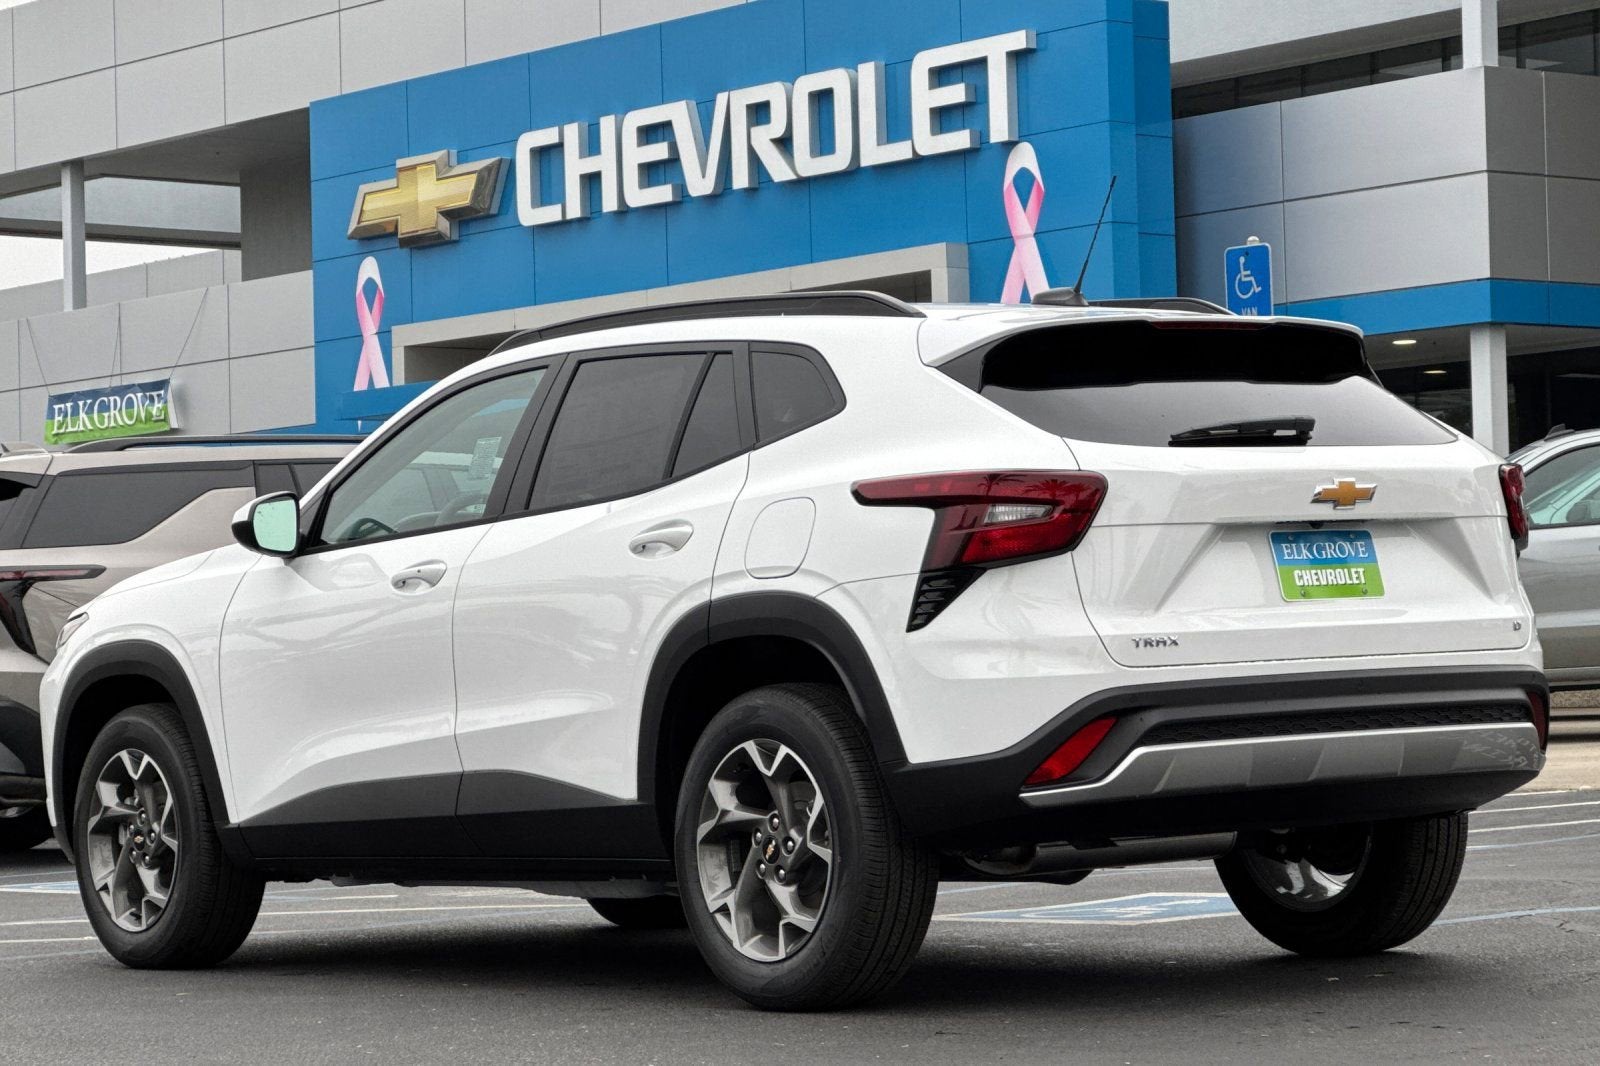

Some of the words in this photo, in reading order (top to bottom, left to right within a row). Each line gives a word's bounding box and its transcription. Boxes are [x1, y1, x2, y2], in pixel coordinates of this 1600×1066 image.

[516, 29, 1036, 226] CHEVROLET
[52, 400, 93, 434] ELK
[93, 390, 165, 429] GROVE
[1281, 543, 1314, 560] ELK
[1313, 541, 1369, 559] GROVE
[1294, 568, 1366, 586] CHEVROLET
[1131, 635, 1179, 648] TRAX
